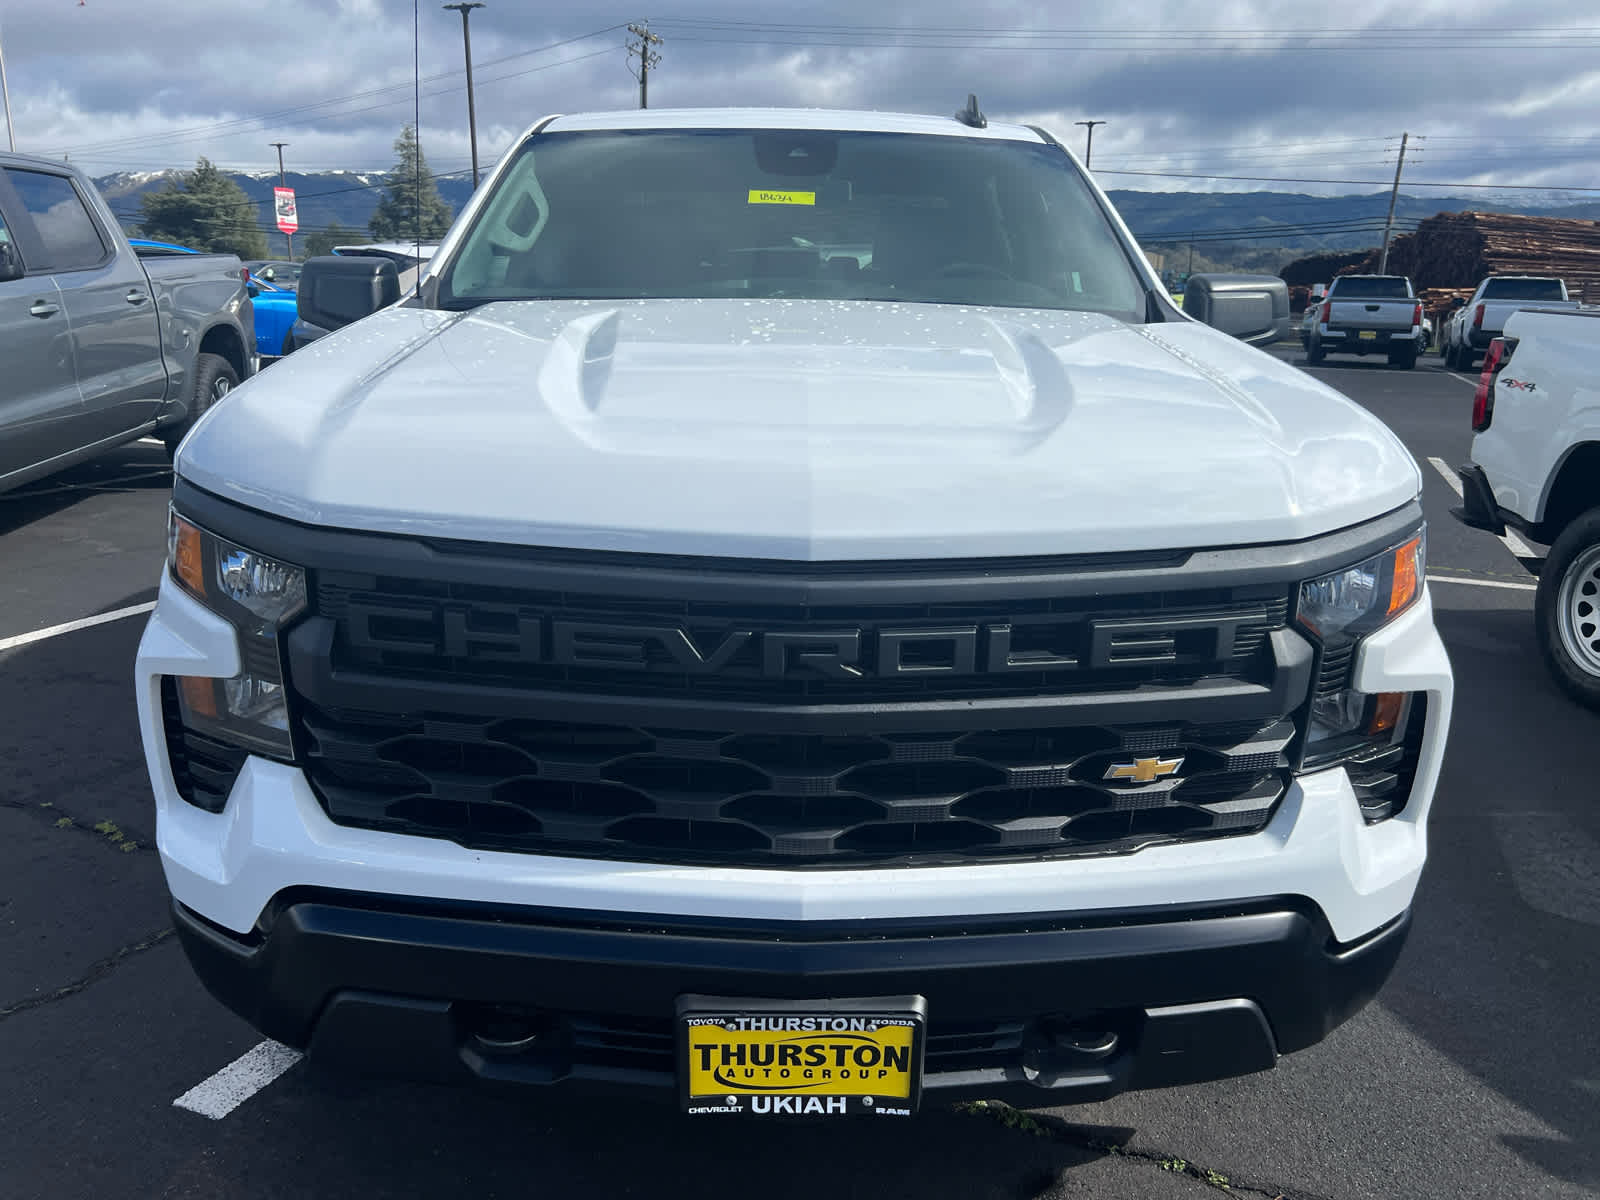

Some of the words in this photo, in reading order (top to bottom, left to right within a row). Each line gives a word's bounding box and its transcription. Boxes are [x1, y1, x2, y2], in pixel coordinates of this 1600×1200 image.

[346, 600, 1268, 680] CHEVROLET
[687, 1018, 726, 1026] TOYOTA
[735, 1017, 865, 1032] THURSTON
[694, 1044, 909, 1072] THURSTON
[726, 1068, 790, 1078] AUTO
[803, 1069, 887, 1079] GROUP
[689, 1106, 743, 1114] CHEVROLET
[751, 1096, 846, 1114] UKIAH
[875, 1107, 910, 1116] RAM
